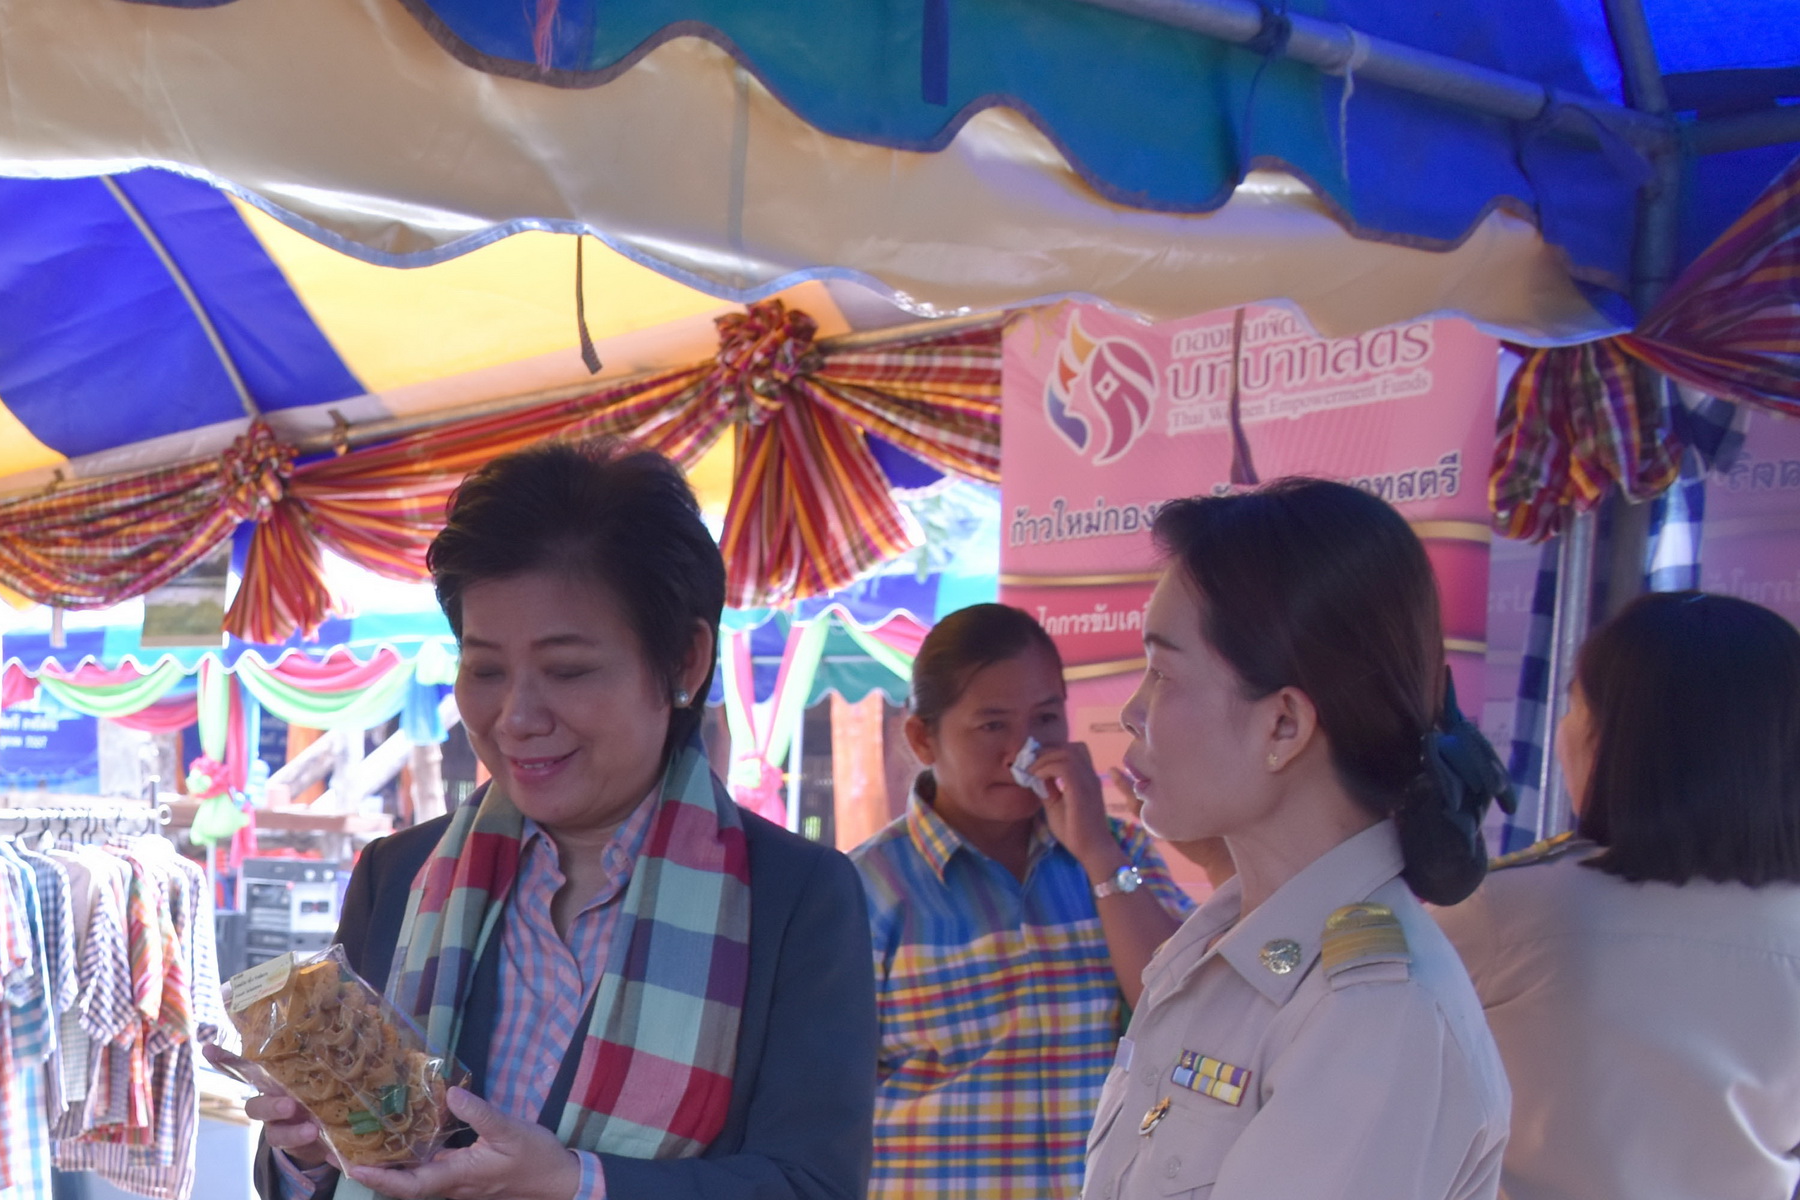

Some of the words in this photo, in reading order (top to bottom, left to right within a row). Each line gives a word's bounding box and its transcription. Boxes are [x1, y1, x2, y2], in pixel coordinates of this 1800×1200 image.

[1210, 404, 1266, 421] Wmen
[1270, 384, 1377, 420] Empowerment
[1381, 372, 1428, 396] Funds
